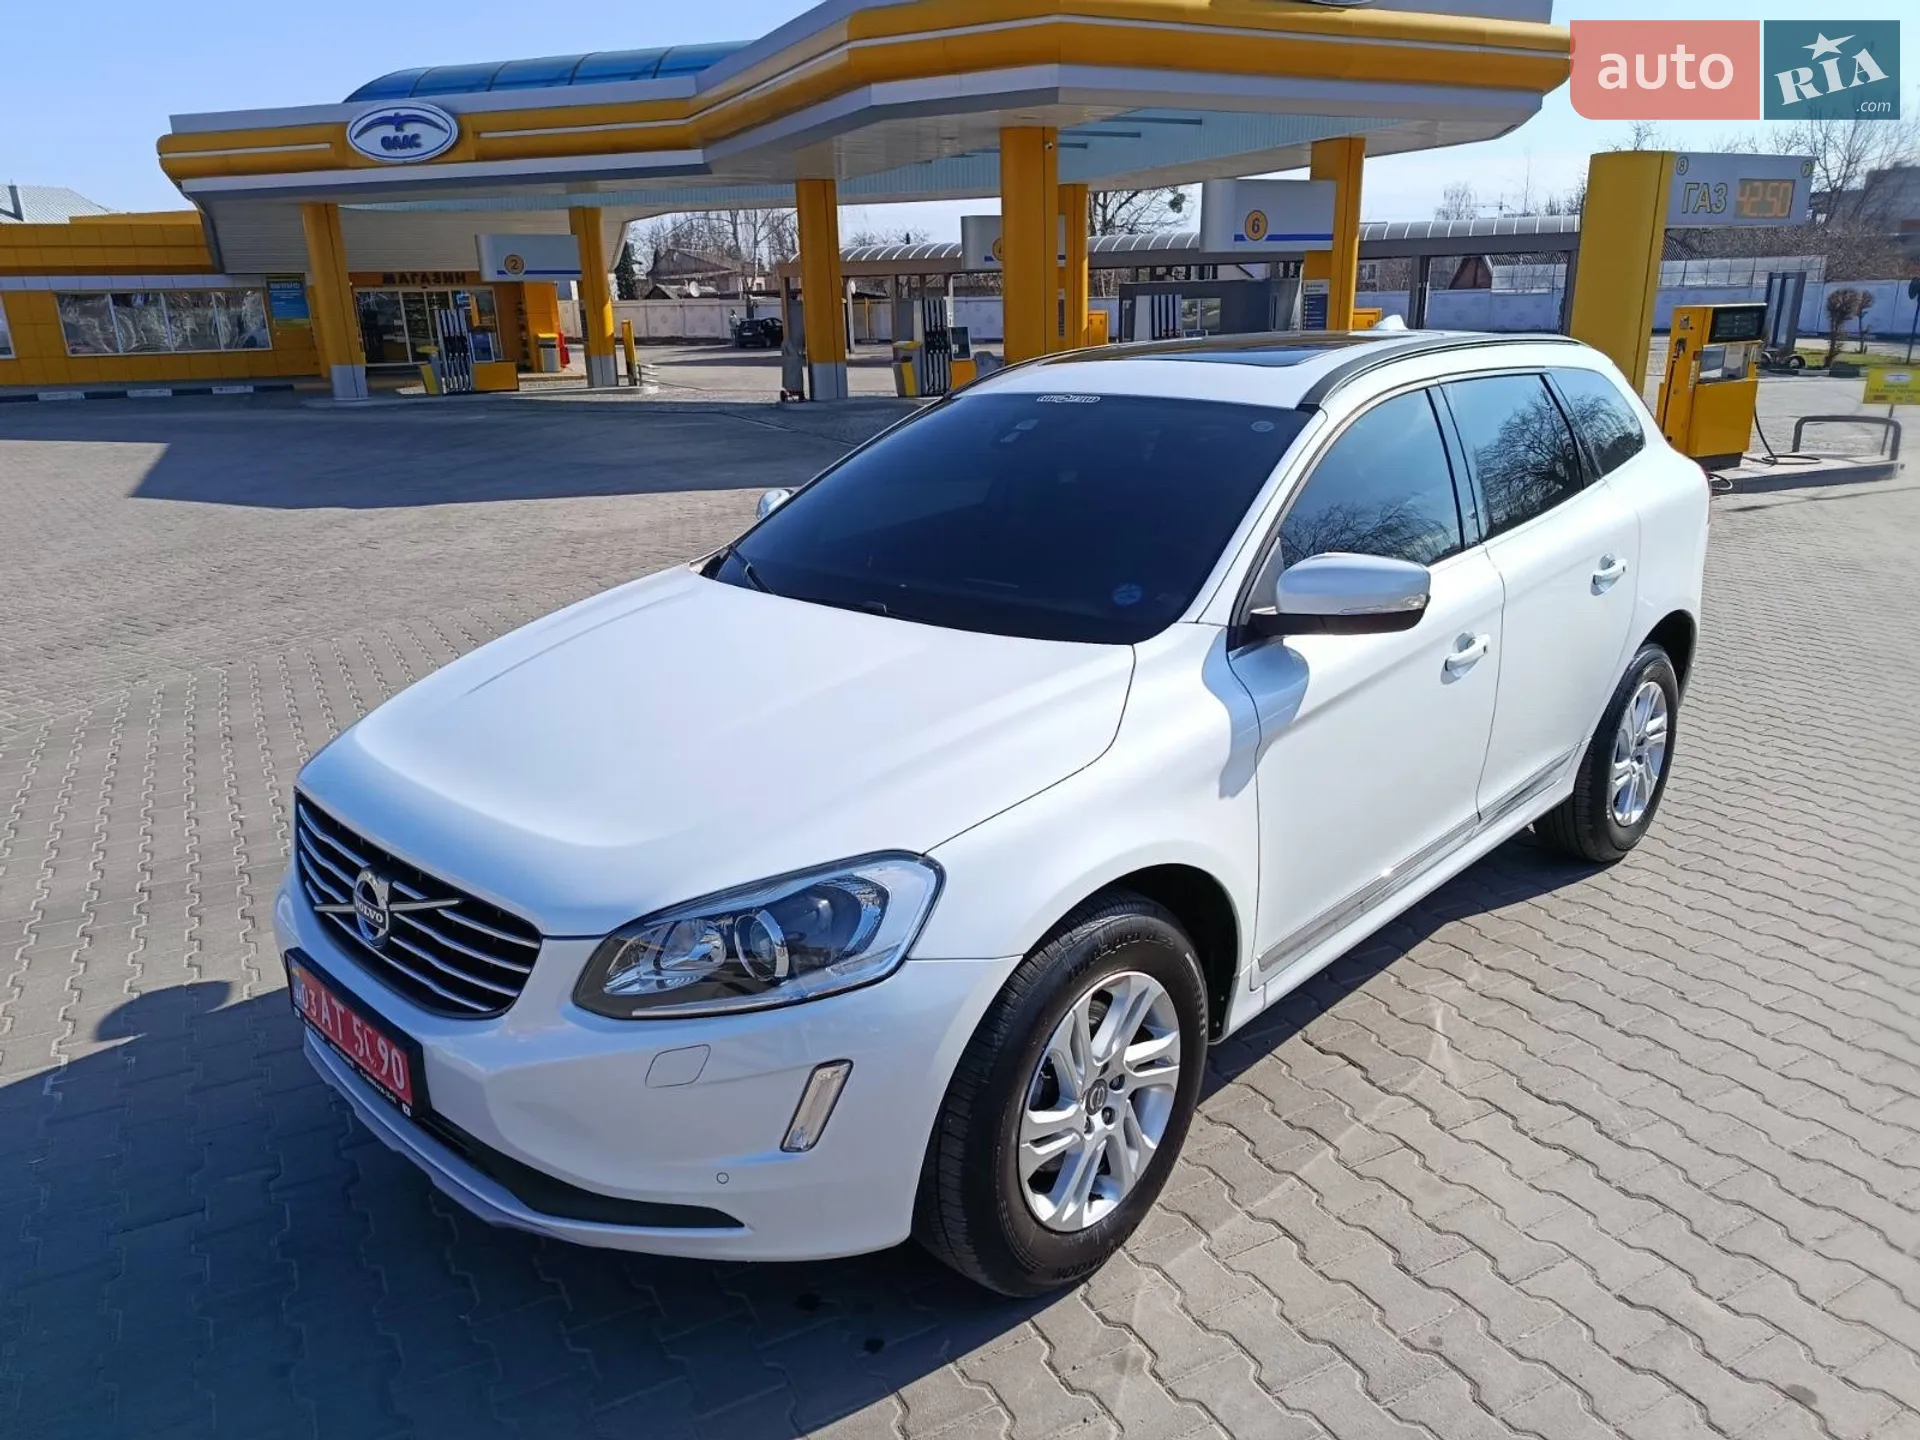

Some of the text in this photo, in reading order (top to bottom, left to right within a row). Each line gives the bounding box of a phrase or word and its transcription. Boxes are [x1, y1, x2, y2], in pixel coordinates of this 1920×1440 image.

[1681, 182, 1728, 214] ГАЗ
[1251, 217, 1260, 234] 6
[383, 272, 466, 284] МАГАЗИН
[356, 899, 383, 923] VOLVO
[321, 988, 345, 1041] AT
